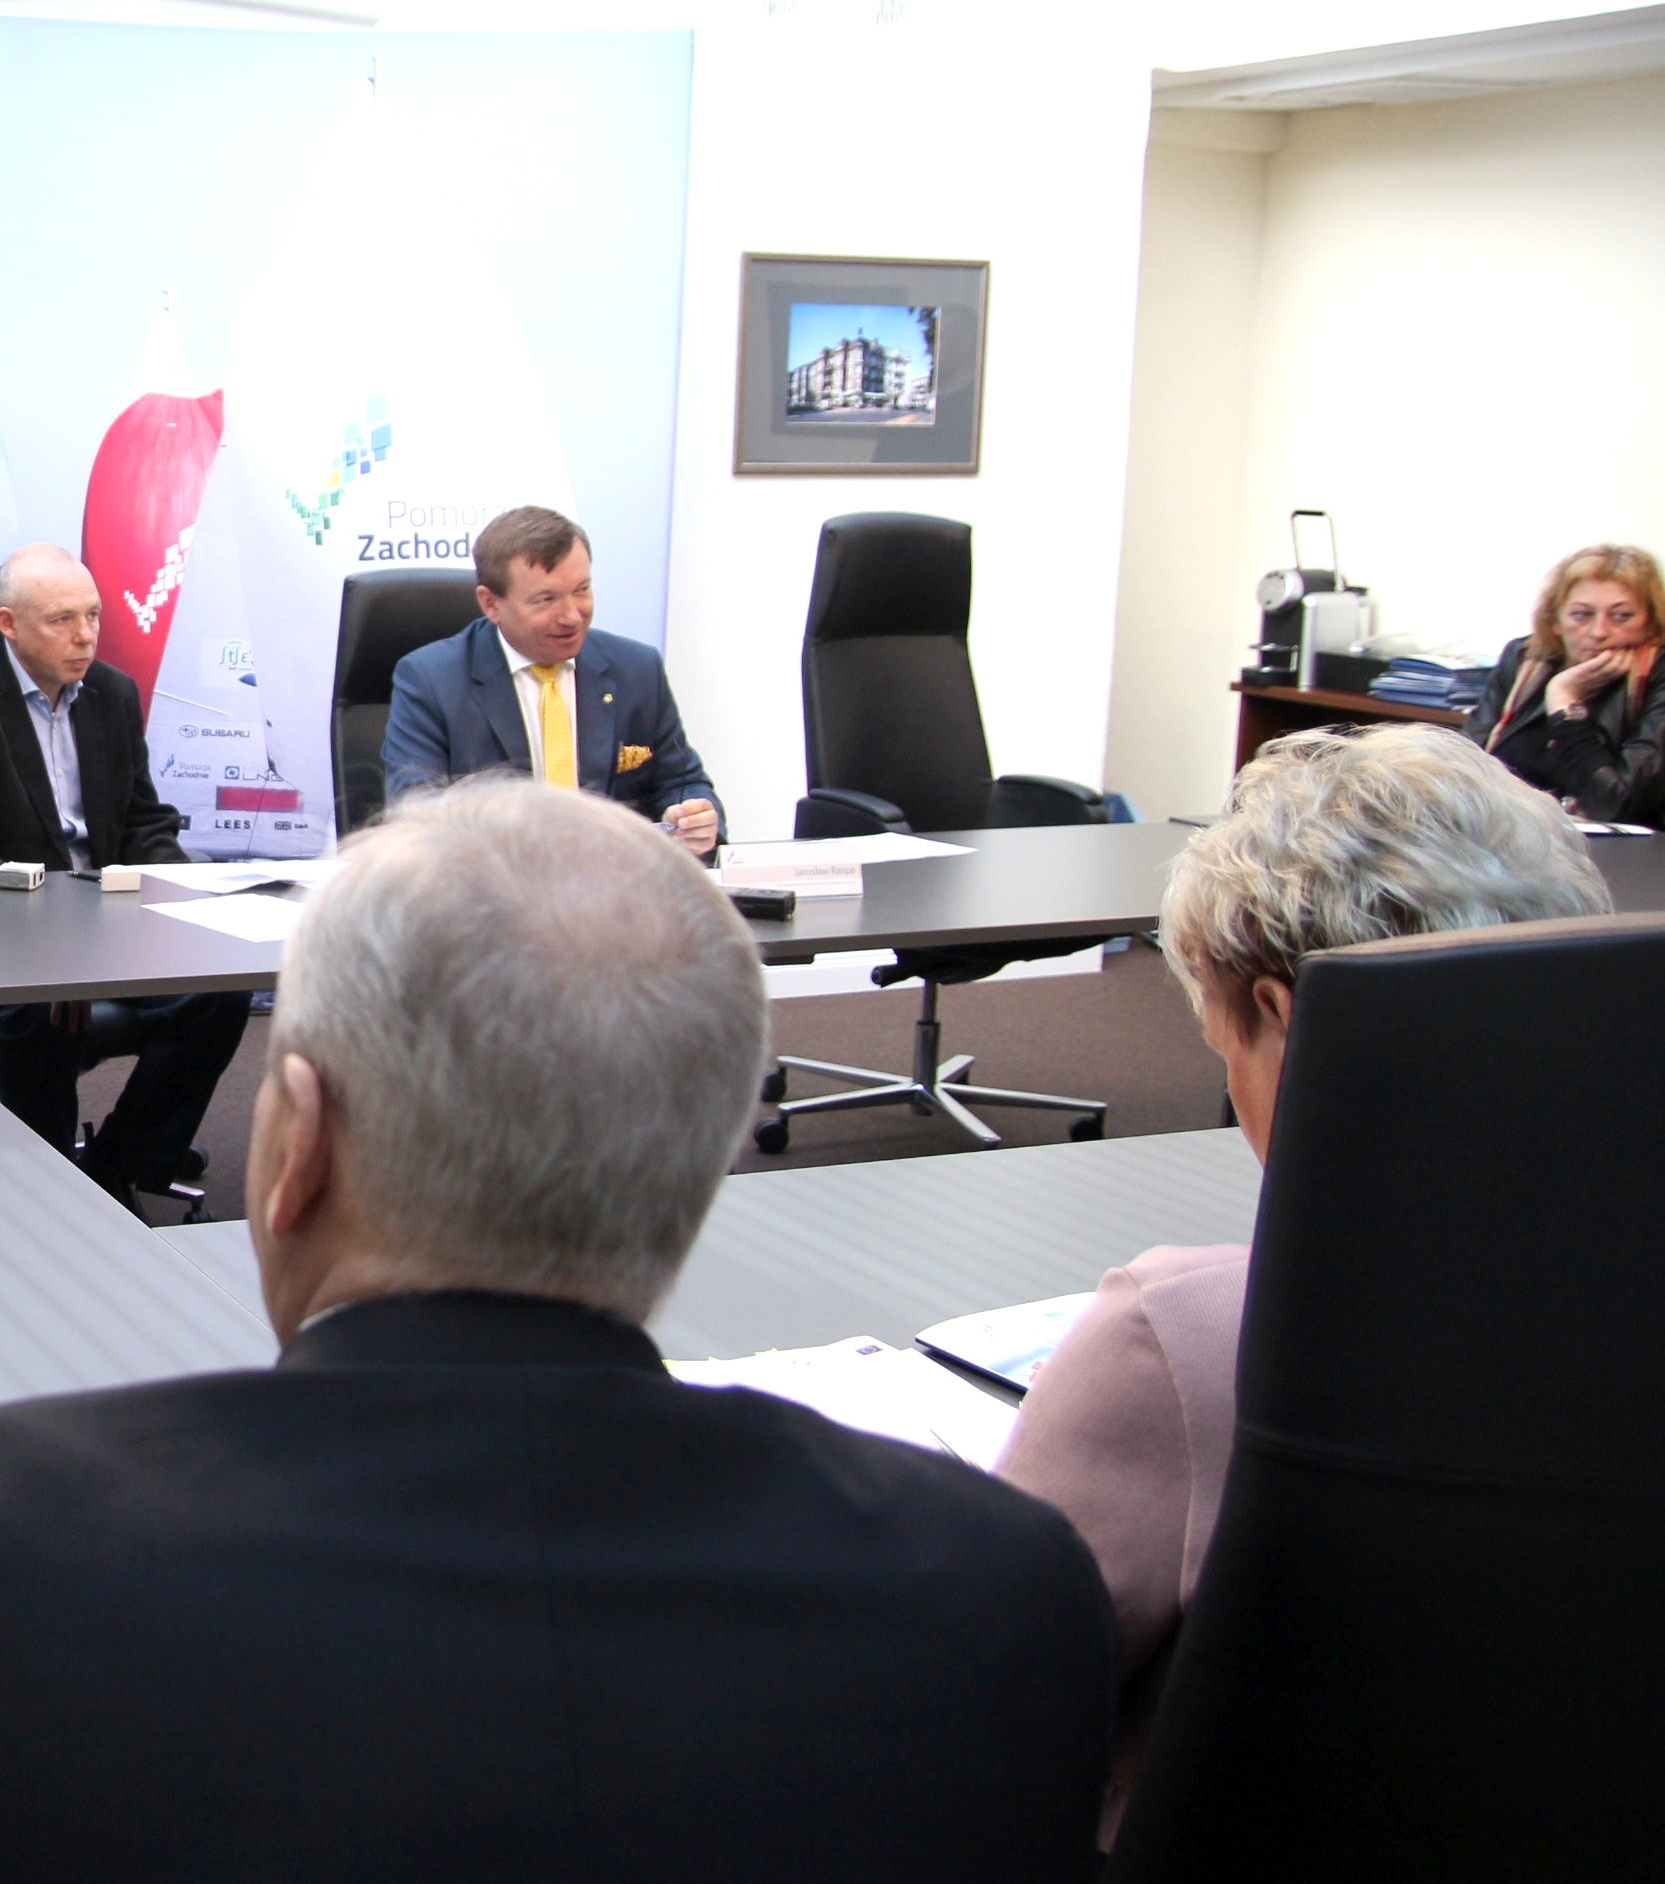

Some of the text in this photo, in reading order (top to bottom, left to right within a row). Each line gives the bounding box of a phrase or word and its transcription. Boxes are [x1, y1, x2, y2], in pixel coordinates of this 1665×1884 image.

[357, 532, 470, 561] Zachod
[201, 728, 250, 738] SUBARU
[172, 769, 210, 779] Zachodnie
[215, 819, 252, 830] LEES
